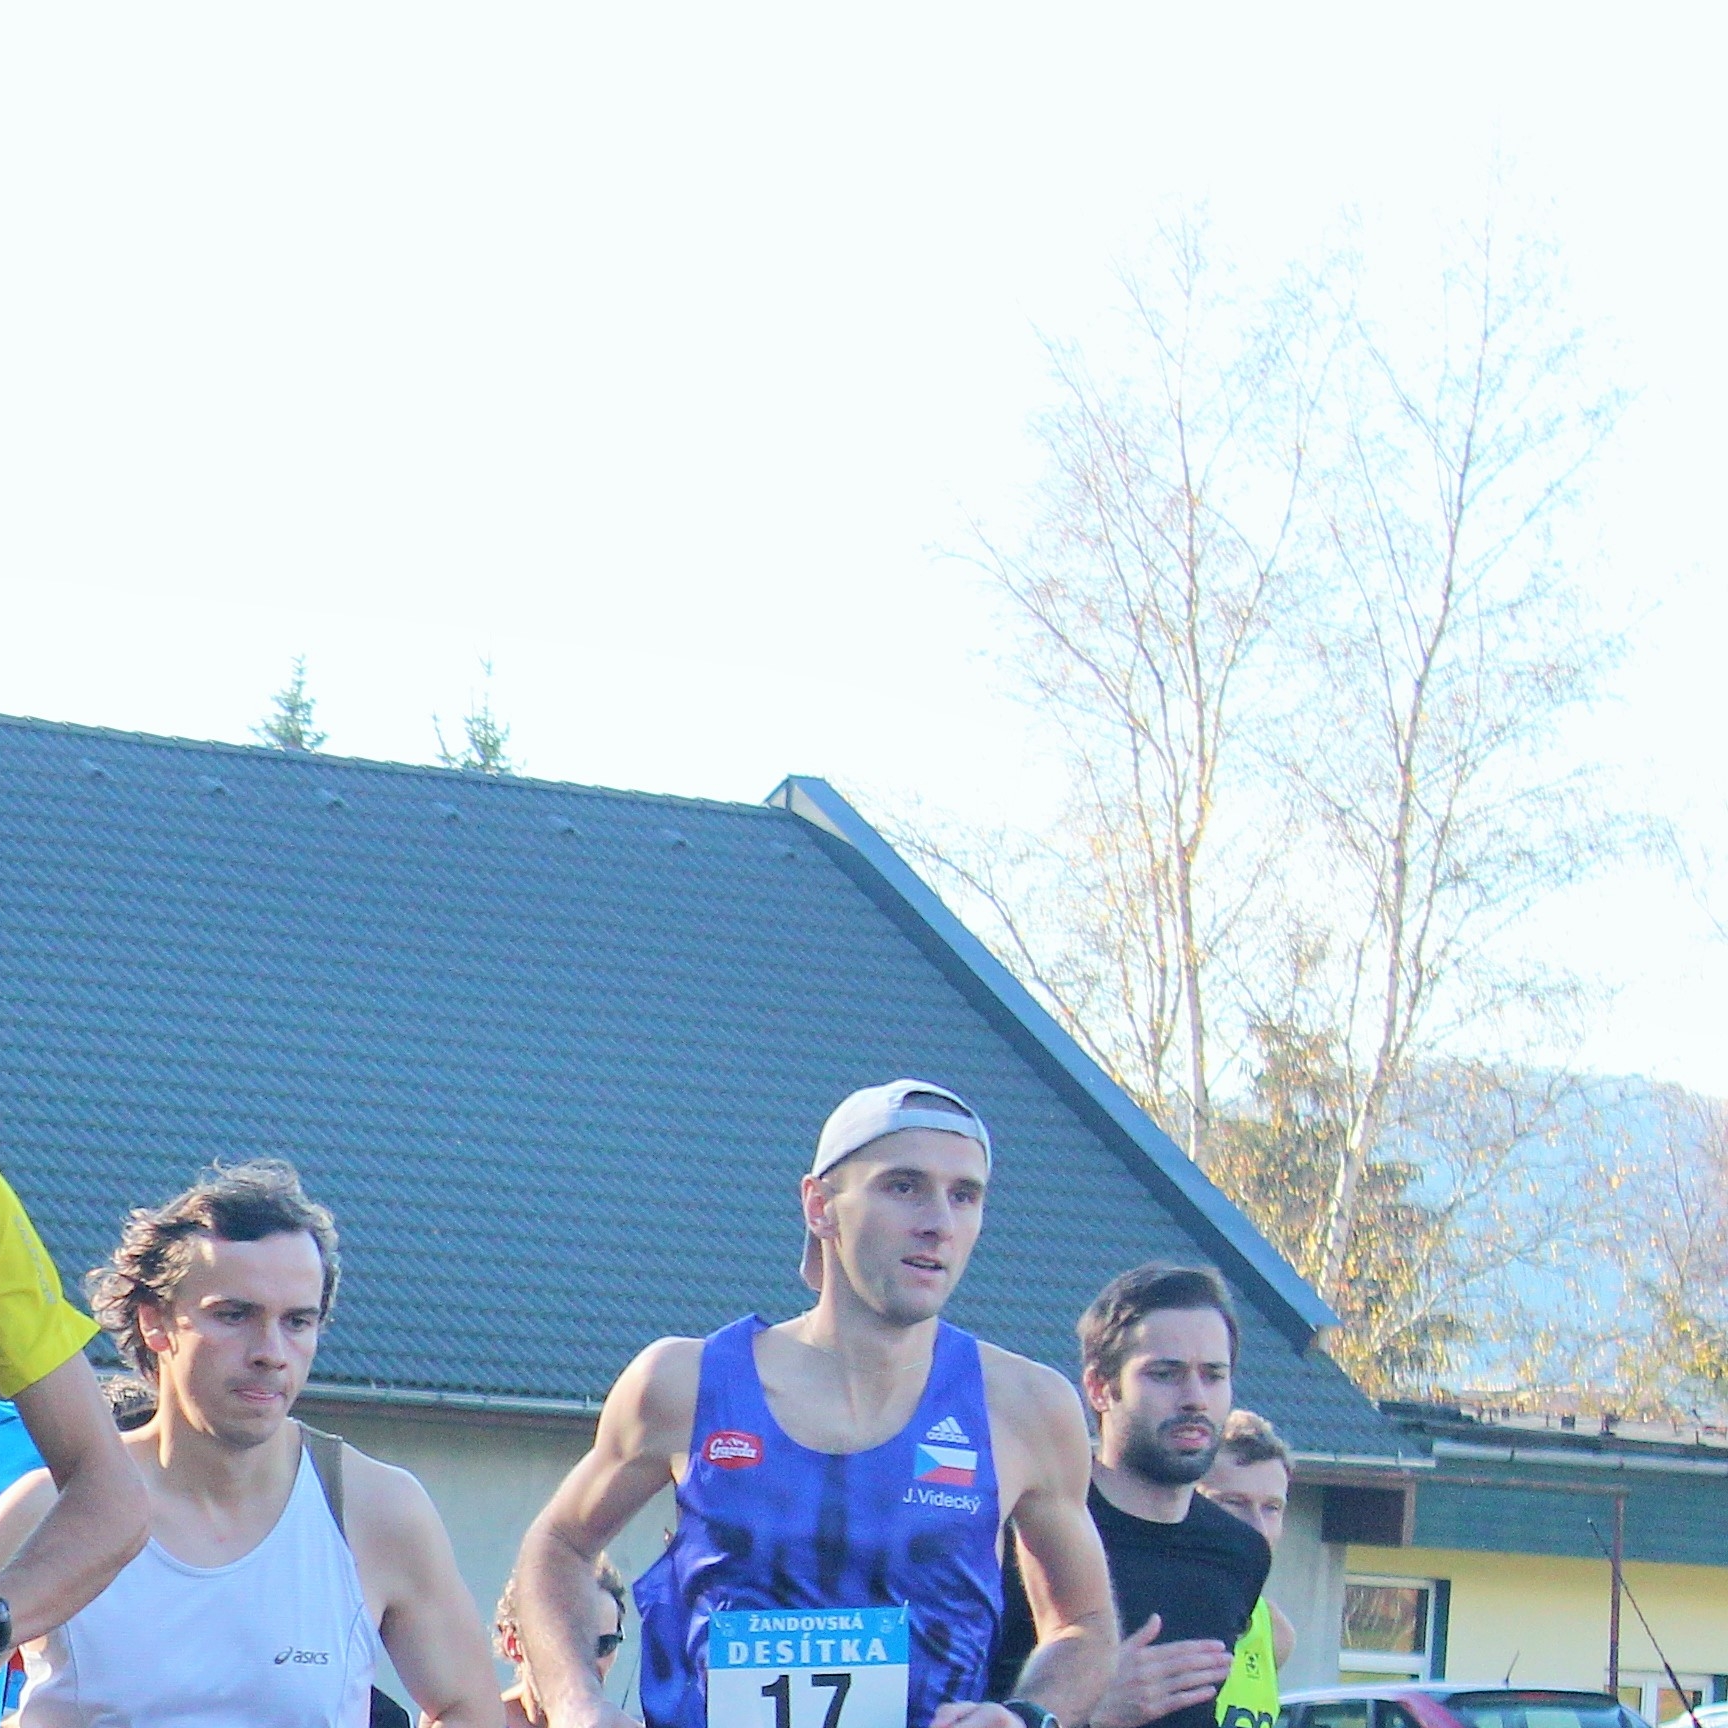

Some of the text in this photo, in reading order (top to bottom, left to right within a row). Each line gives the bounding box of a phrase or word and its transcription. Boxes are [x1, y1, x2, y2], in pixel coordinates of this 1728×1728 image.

[748, 1612, 865, 1633] ŽANDOVSKÁ
[294, 1650, 329, 1665] asics
[727, 1632, 888, 1665] DESÍTKA
